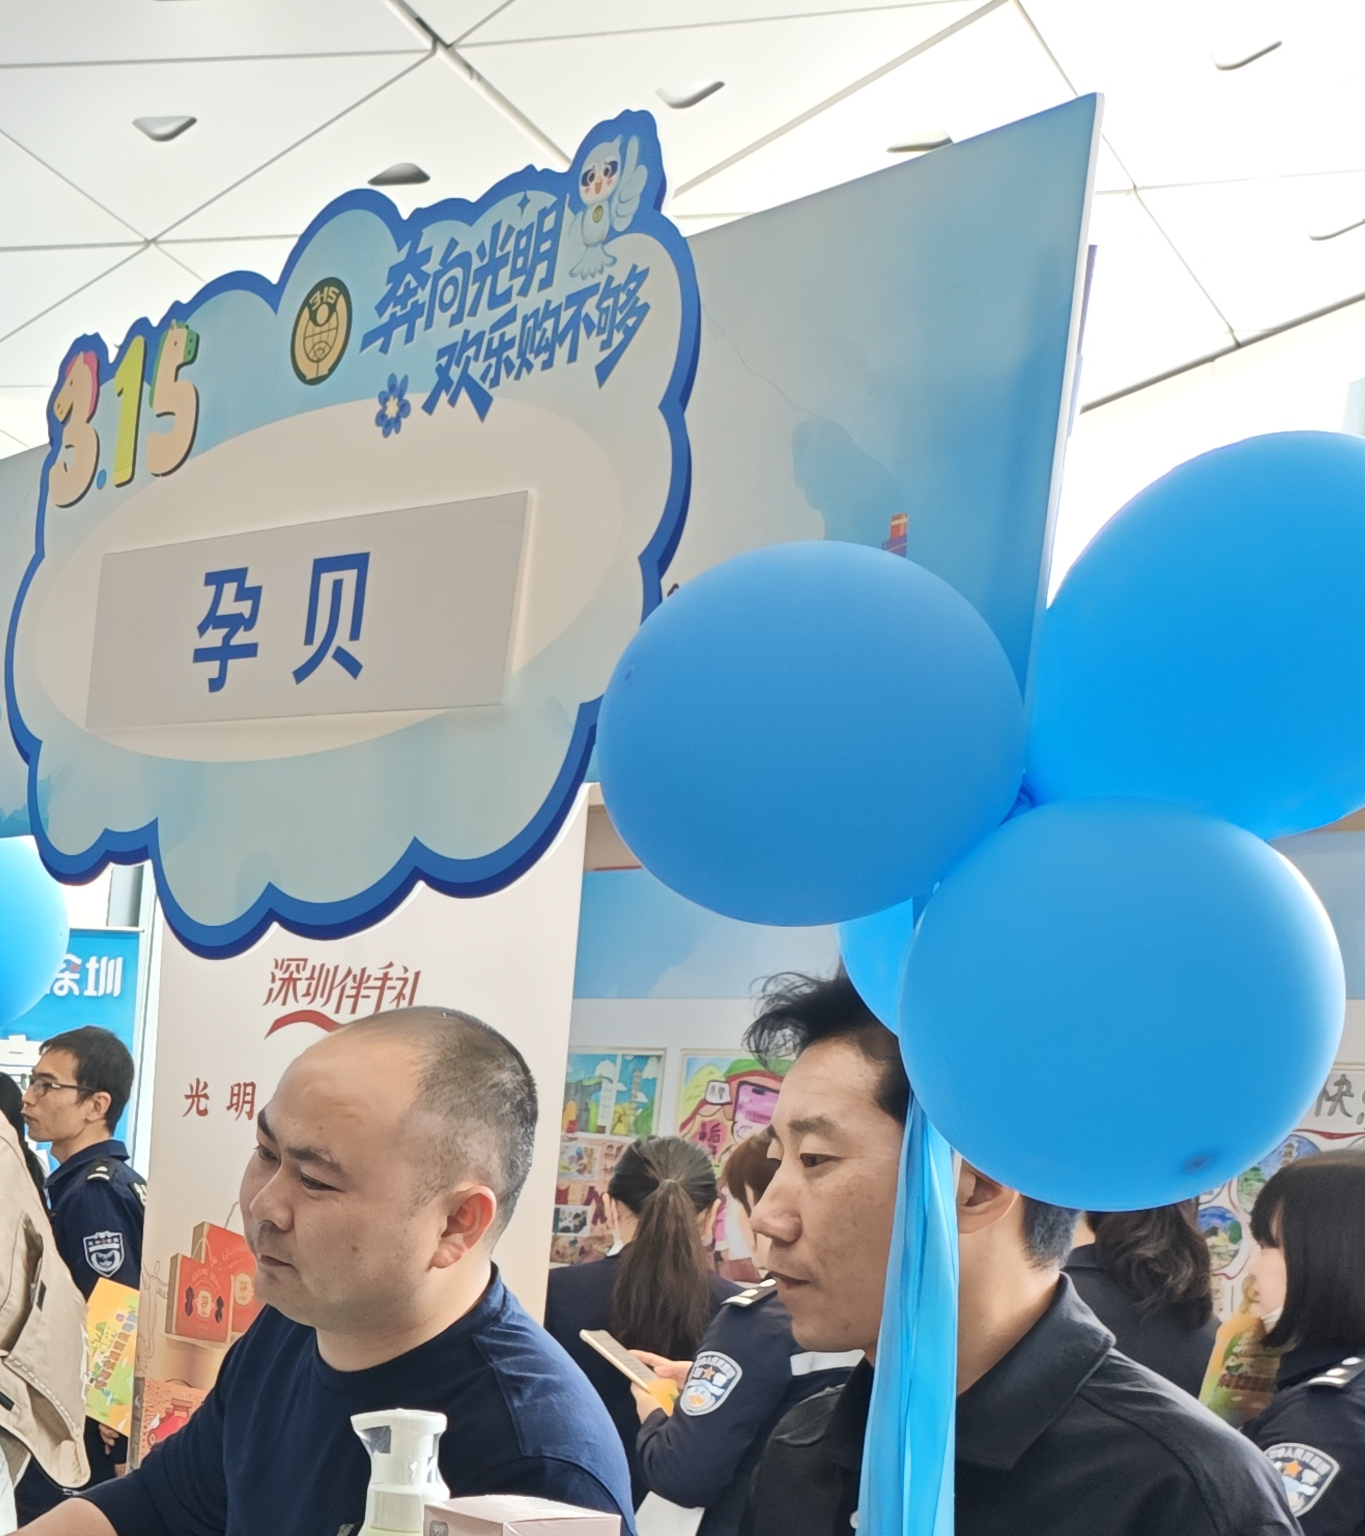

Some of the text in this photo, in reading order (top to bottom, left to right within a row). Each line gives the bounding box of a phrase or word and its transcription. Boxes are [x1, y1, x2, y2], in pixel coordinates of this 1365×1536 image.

[360, 204, 563, 355] 奔向光明
[423, 264, 650, 422] 欢乐购不够
[192, 551, 371, 693] 孕贝
[262, 957, 422, 1015] 深圳伴手礼
[182, 1077, 256, 1121] 光明
